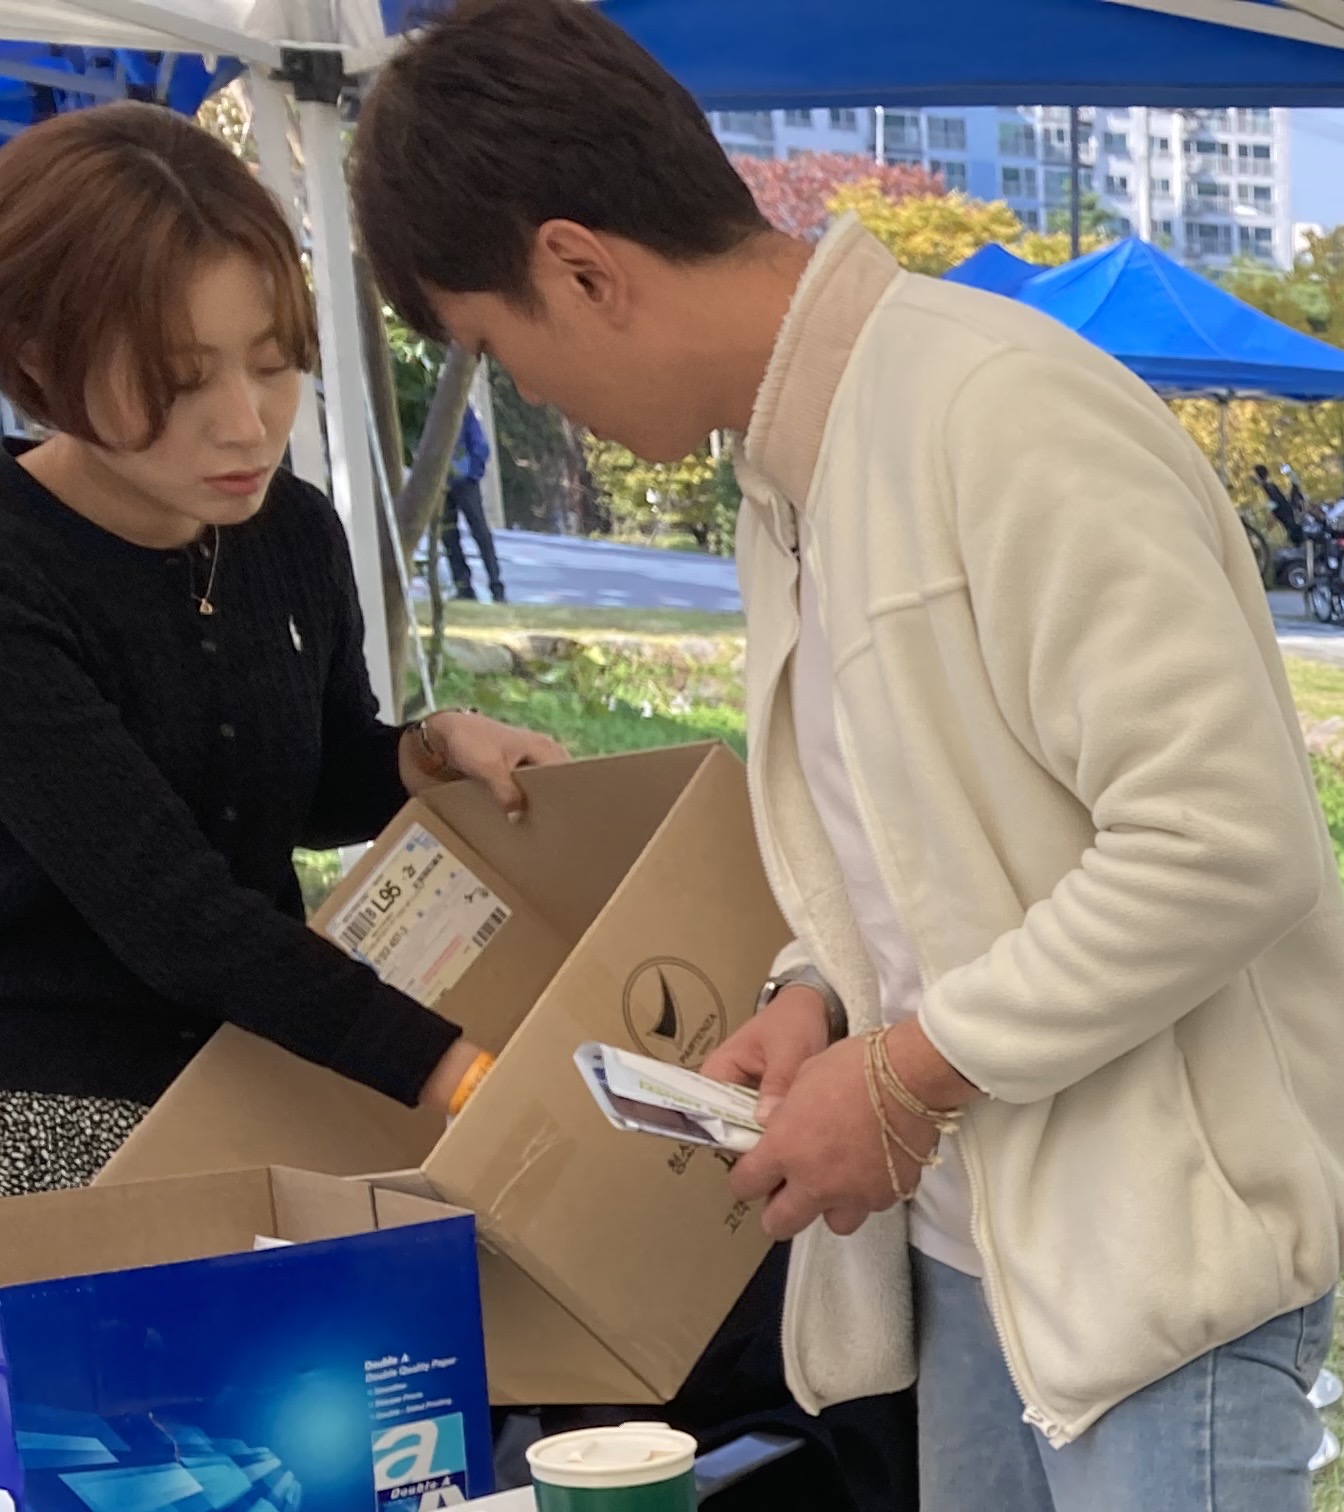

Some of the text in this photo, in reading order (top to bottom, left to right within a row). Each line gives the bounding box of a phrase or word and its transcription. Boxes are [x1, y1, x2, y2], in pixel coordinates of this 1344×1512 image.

[364, 1352, 411, 1370] Double A
[390, 1476, 452, 1500] Double A
